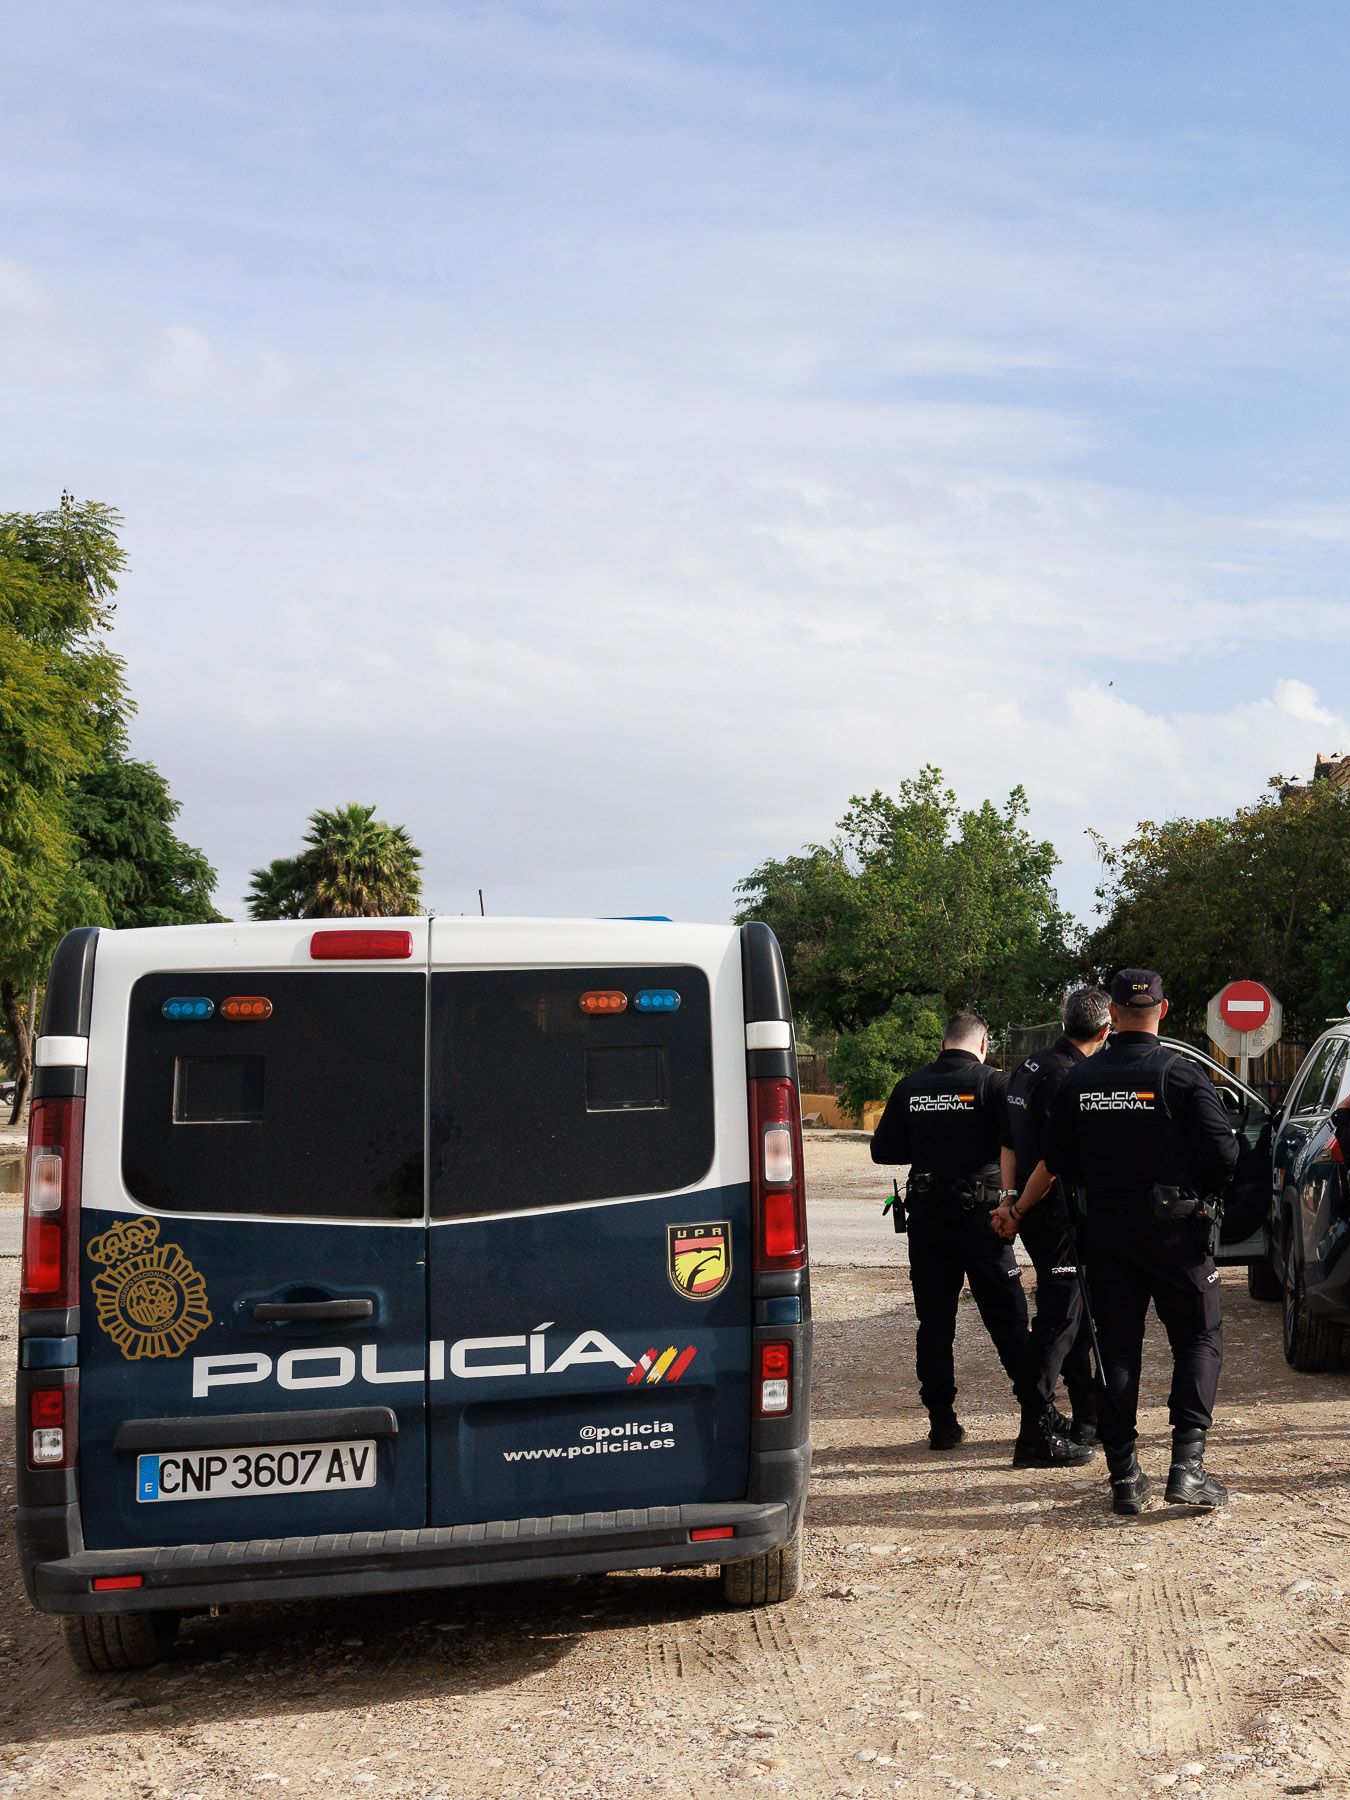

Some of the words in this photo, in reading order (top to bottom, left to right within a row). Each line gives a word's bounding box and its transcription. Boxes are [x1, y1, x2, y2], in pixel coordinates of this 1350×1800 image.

[909, 1094, 961, 1104] POLICIA
[1080, 1091, 1138, 1102] POLICIA
[909, 1102, 975, 1112] NACIONAL
[1080, 1100, 1155, 1111] NACIONAL
[120, 1280, 134, 1307] CUERPO
[133, 1270, 167, 1282] NACIONAL
[168, 1276, 177, 1286] DE
[192, 1321, 638, 1398] POLICÍA
[579, 1420, 674, 1440] @policia
[502, 1437, 676, 1462] www.policia.es
[145, 1482, 153, 1493] E
